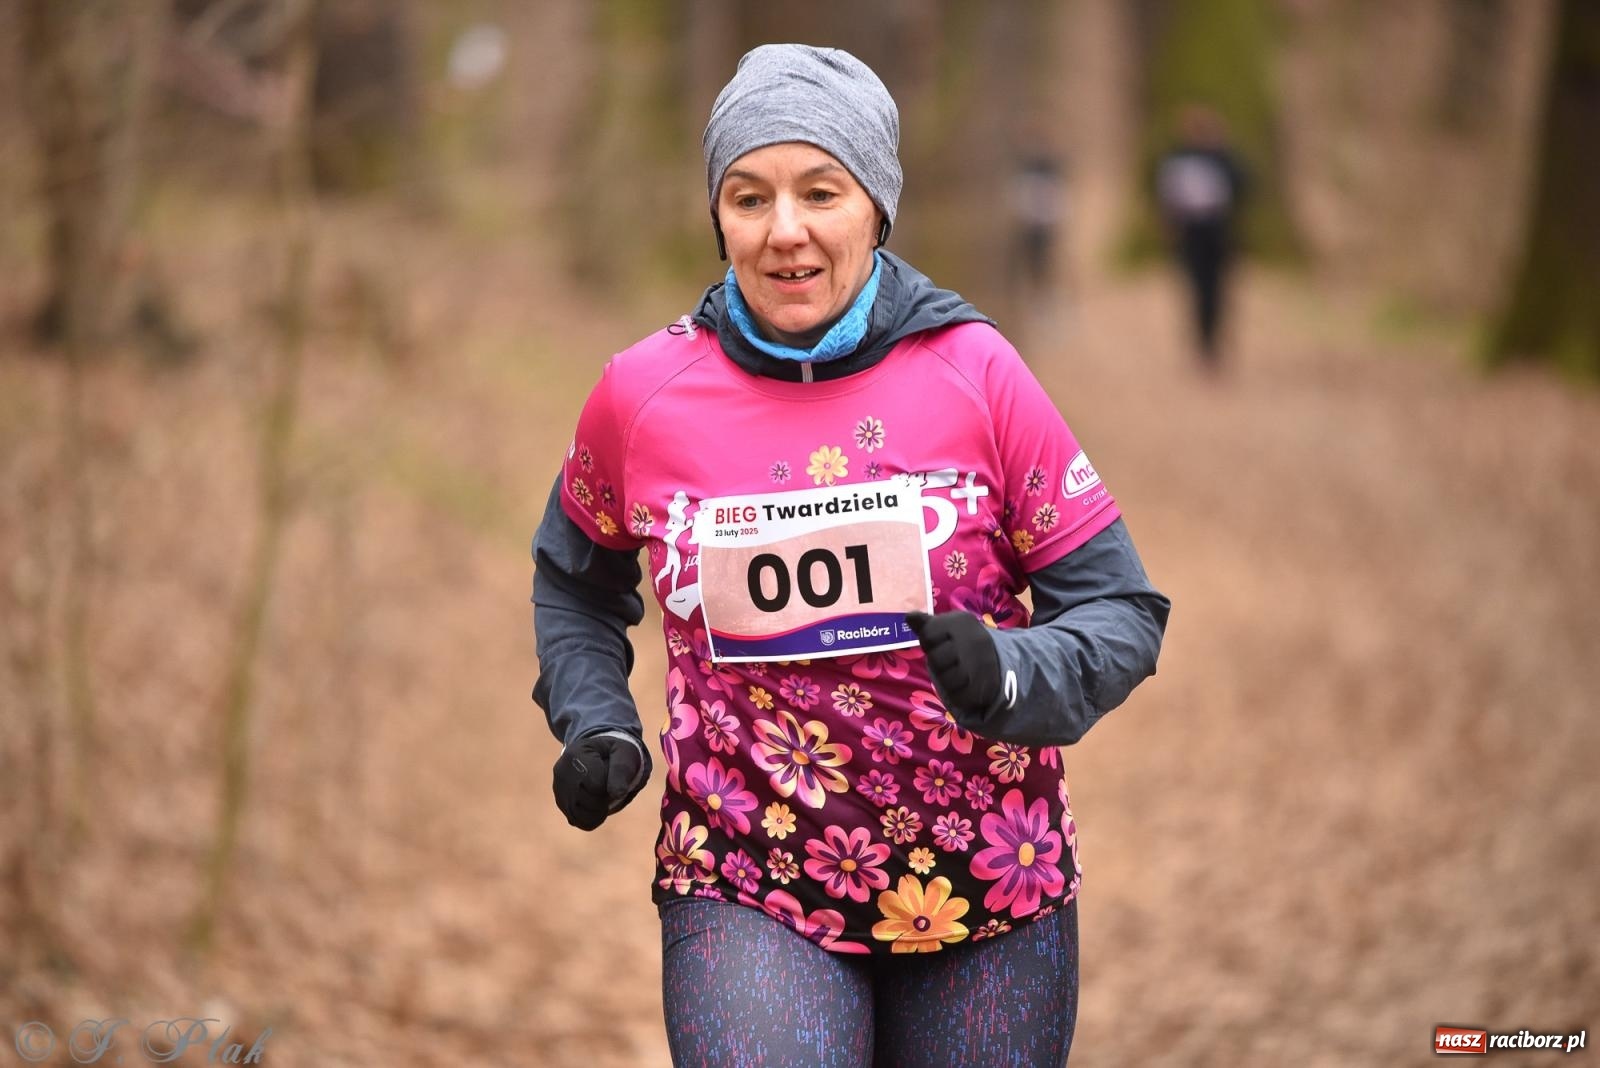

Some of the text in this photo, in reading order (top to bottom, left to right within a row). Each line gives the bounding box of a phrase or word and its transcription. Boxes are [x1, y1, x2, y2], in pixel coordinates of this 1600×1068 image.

[715, 492, 899, 525] BIEG Twardziela
[715, 527, 759, 538] 23 luty 2025
[747, 544, 874, 613] 001
[837, 626, 891, 641] Racibórz
